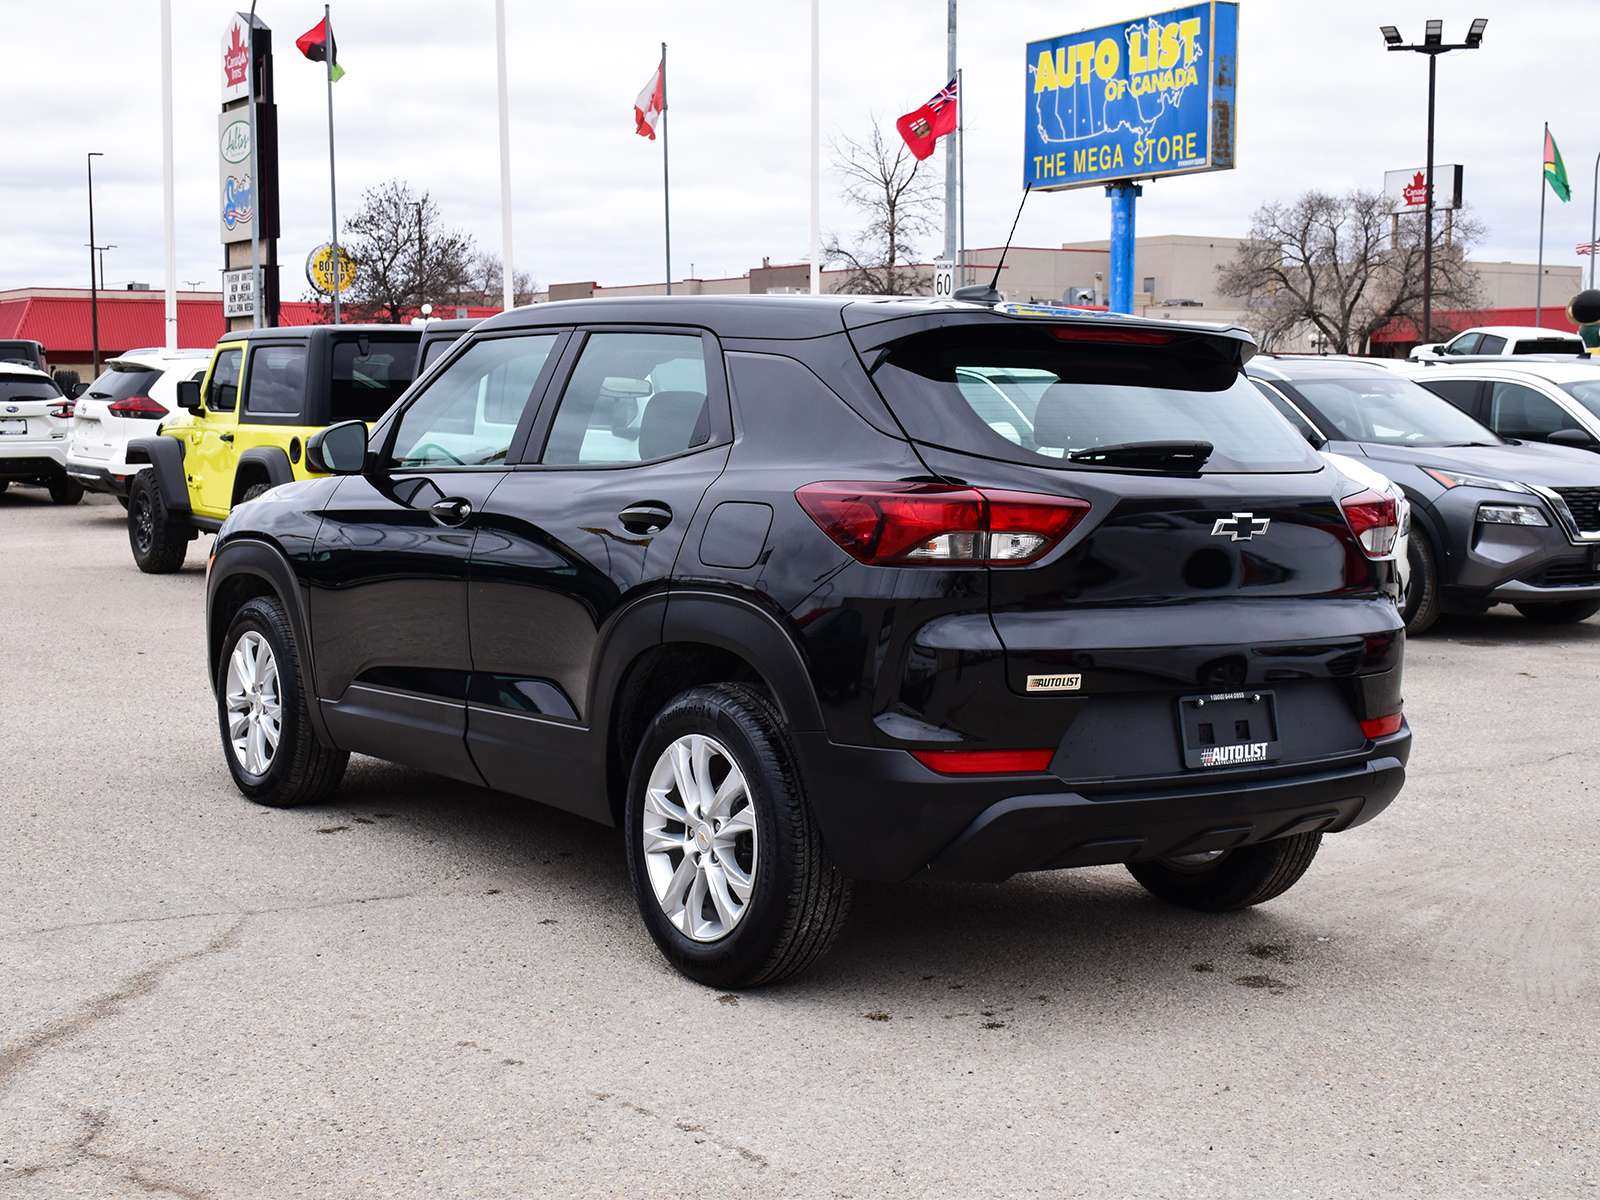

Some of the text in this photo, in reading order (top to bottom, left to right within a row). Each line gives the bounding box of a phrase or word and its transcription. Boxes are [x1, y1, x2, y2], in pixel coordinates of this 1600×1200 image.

[1034, 17, 1201, 93] AUTO LIST
[1104, 66, 1199, 102] OF CANADA
[1033, 132, 1197, 179] THE MEGA STORE
[319, 261, 350, 272] BOTLE
[324, 272, 346, 282] STP
[936, 273, 951, 296] 60
